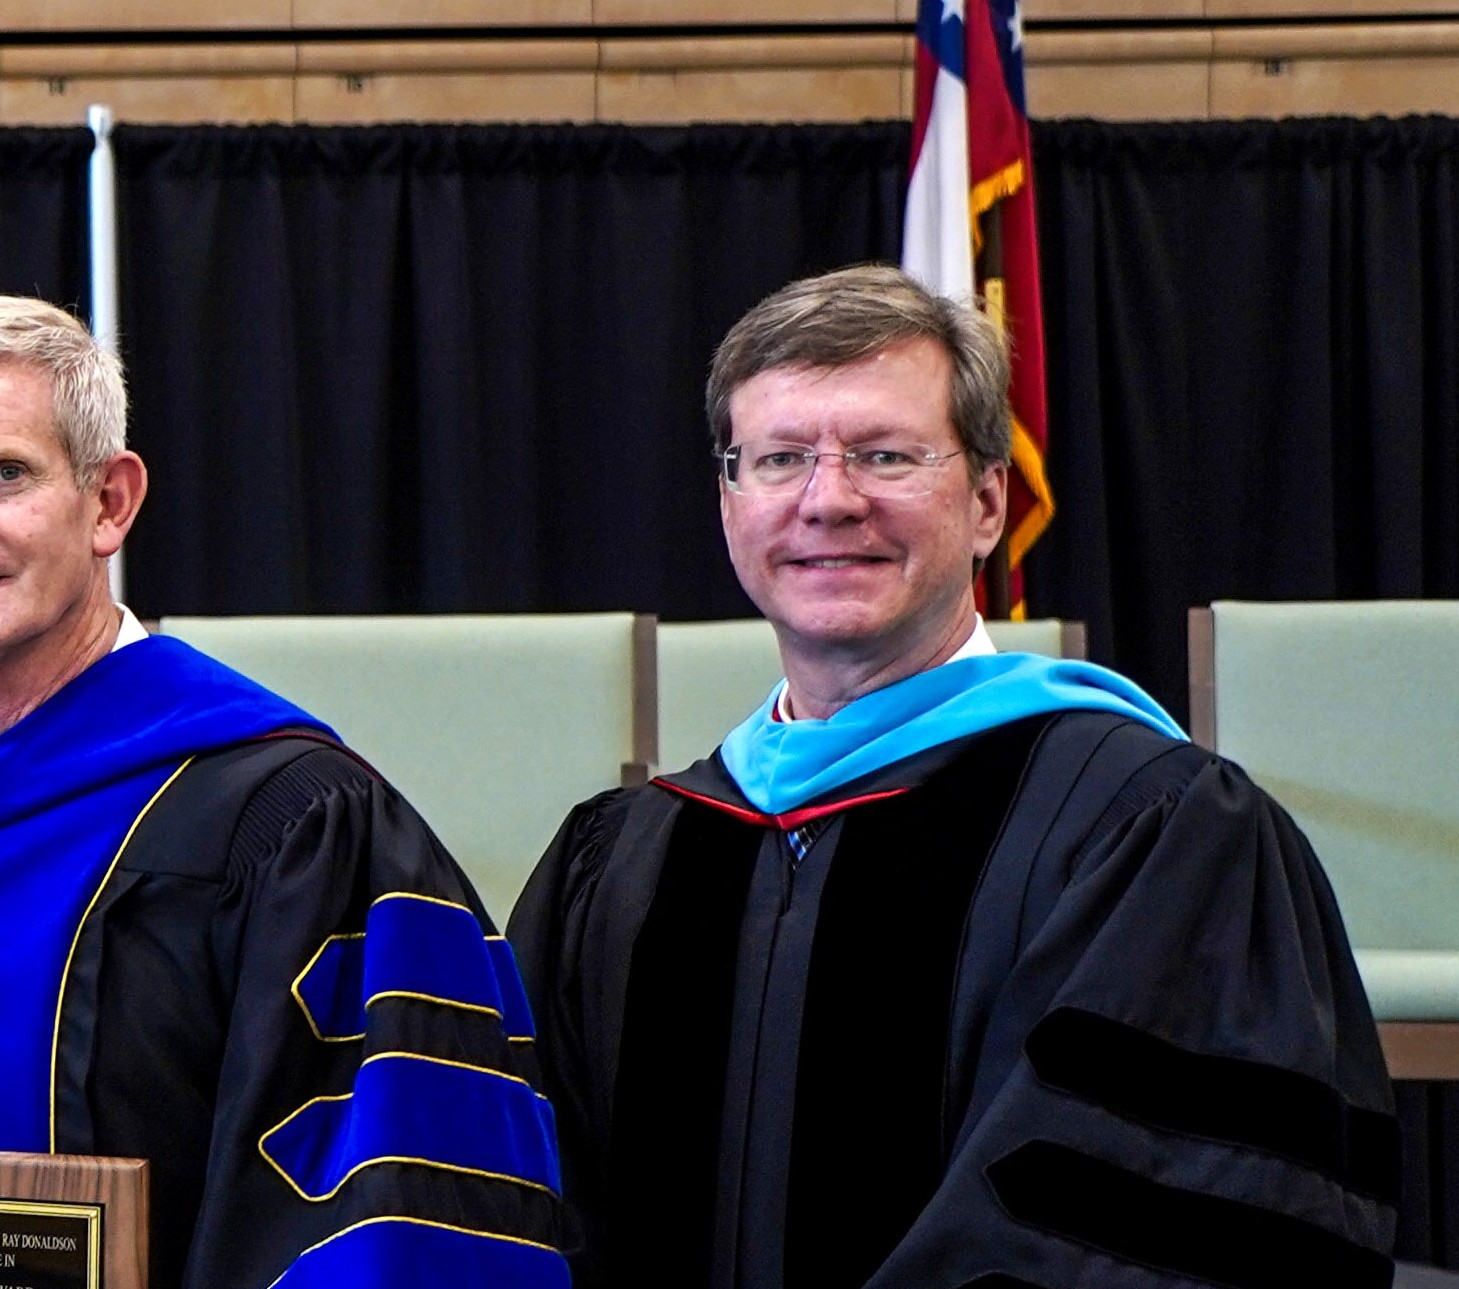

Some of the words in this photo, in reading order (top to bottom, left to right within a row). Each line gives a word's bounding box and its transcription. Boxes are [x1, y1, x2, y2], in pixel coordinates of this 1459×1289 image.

[1, 1232, 20, 1248] RAY
[21, 1233, 77, 1251] DONALDSON
[3, 1253, 15, 1267] IN
